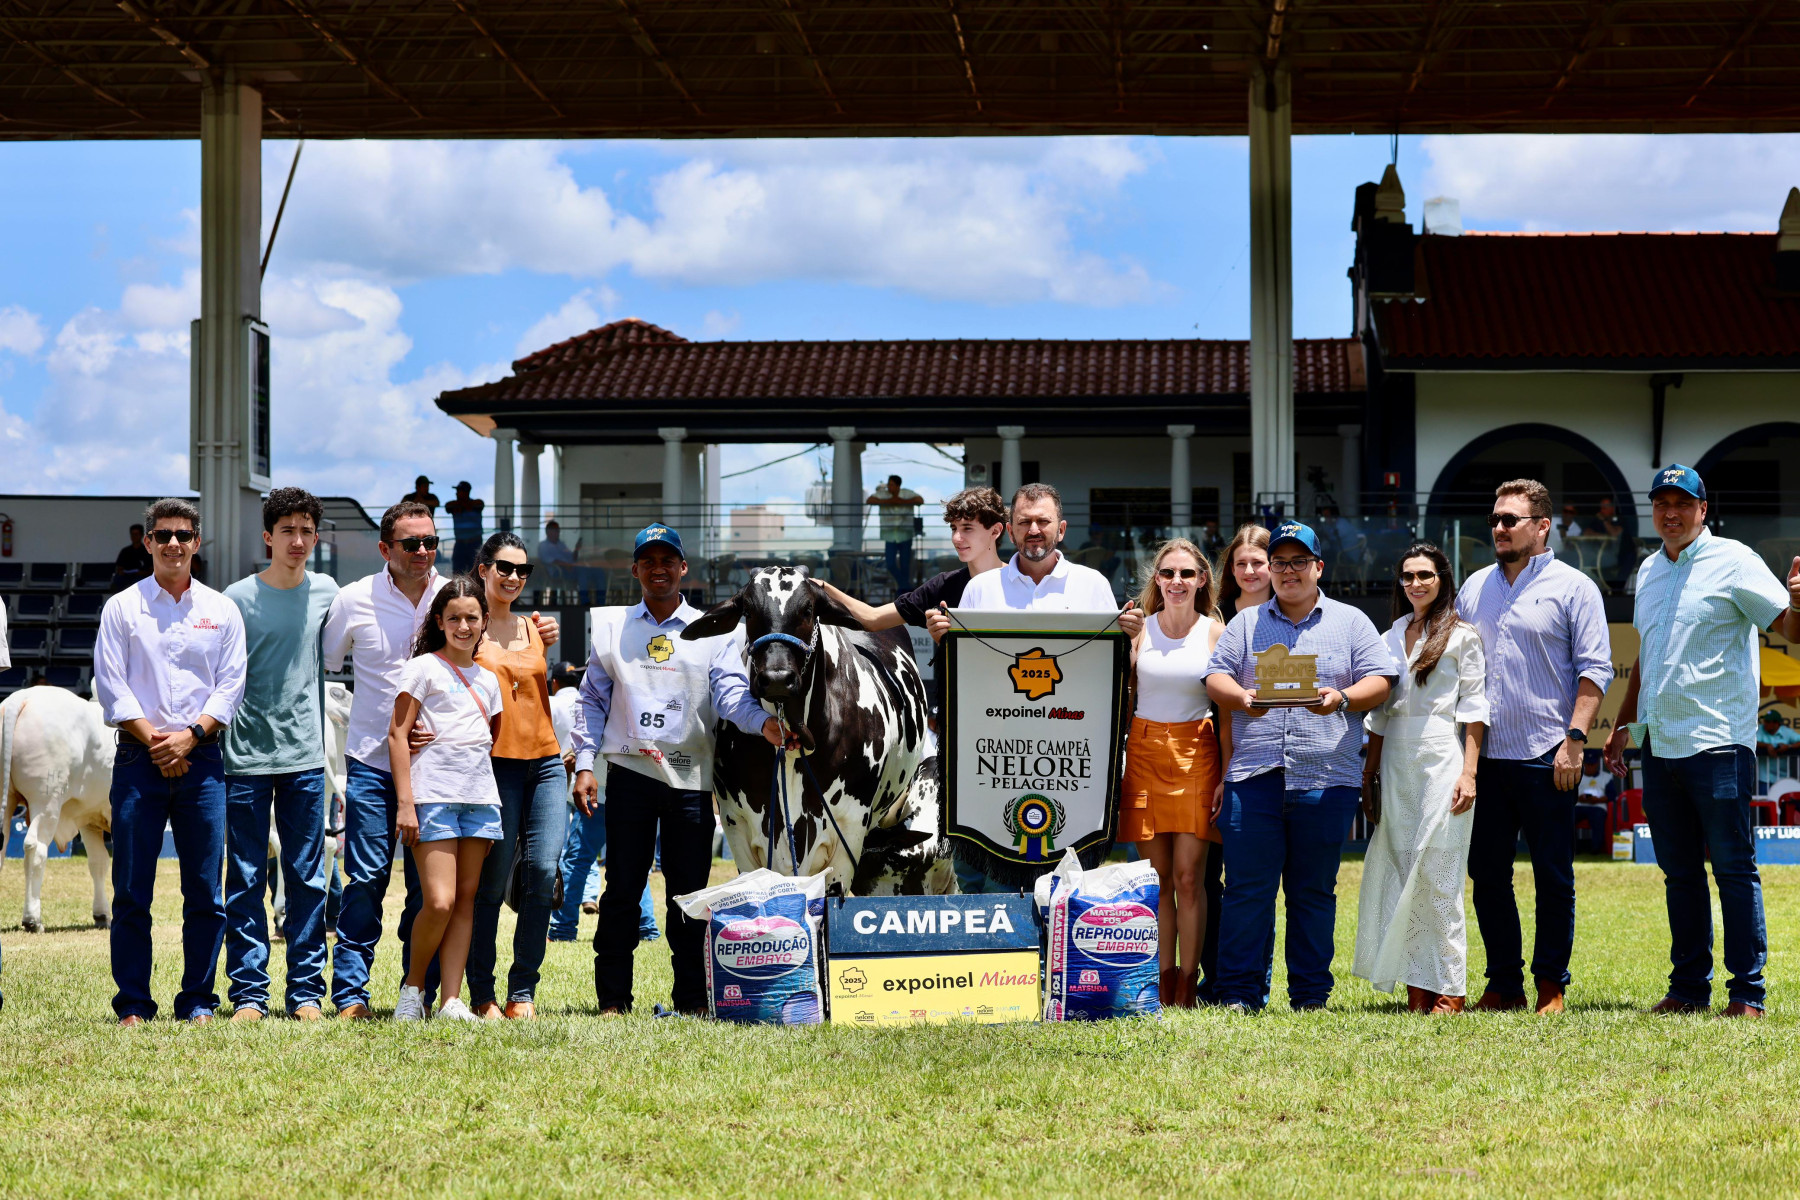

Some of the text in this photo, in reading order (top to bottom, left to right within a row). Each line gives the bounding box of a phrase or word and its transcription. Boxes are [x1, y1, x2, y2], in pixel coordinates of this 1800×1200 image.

[1021, 669, 1050, 678] 2025
[1255, 661, 1317, 677] nelore
[640, 711, 665, 728] 85
[986, 706, 1085, 720] expoinel Minas
[976, 738, 1091, 756] GRANDE CAMPEÃ
[668, 756, 691, 764] nelore
[976, 755, 1091, 778] NELORE
[991, 777, 1079, 791] PELAGENS
[853, 903, 1014, 935] CAMPEÃ
[1090, 909, 1133, 918] MATSUDA
[717, 936, 807, 956] REPRODUÇÃO
[1053, 908, 1063, 970] MATSUDA
[1096, 941, 1149, 952] EMBRYO
[736, 953, 792, 966] EMBRYO
[883, 971, 973, 994] expoinel
[980, 969, 1037, 987] Minas
[716, 999, 752, 1007] MATSUDA
